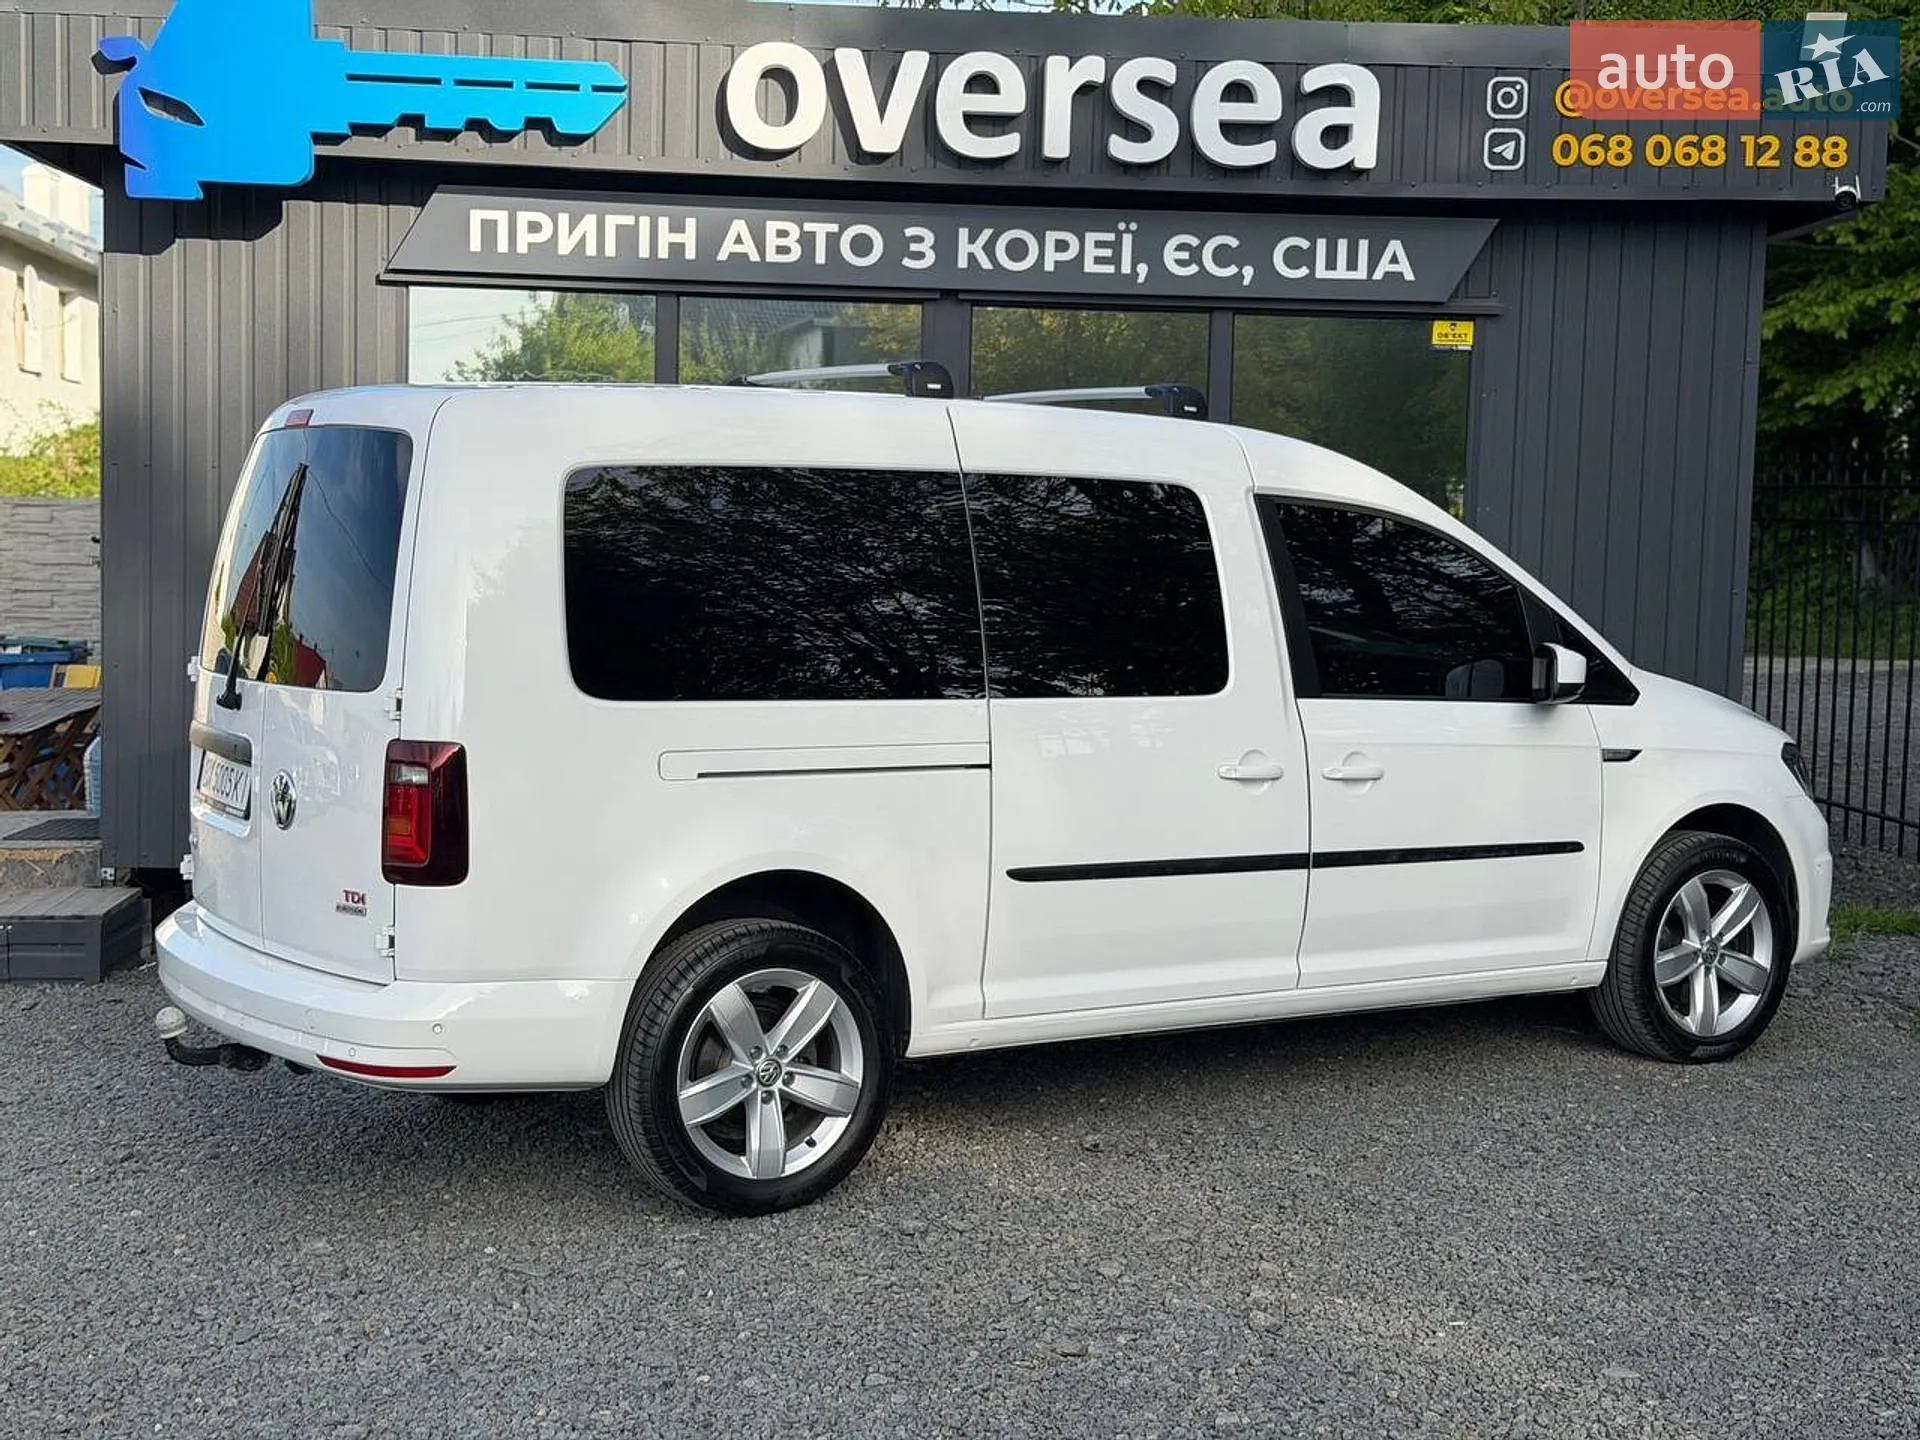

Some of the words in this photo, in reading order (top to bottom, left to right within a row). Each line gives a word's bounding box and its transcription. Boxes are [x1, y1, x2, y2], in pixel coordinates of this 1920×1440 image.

[725, 41, 1382, 172] oversea
[1551, 133, 1634, 168] 068
[1644, 133, 1727, 168] 068
[1740, 135, 1782, 168] 12
[1794, 135, 1849, 168] 88
[468, 208, 698, 262] ПРИГІН
[716, 218, 884, 268] АВТО
[956, 221, 1149, 285] КОРЕЇ,
[1162, 234, 1256, 287] ЄС,
[1272, 236, 1416, 282] США
[343, 889, 366, 906] TDI
